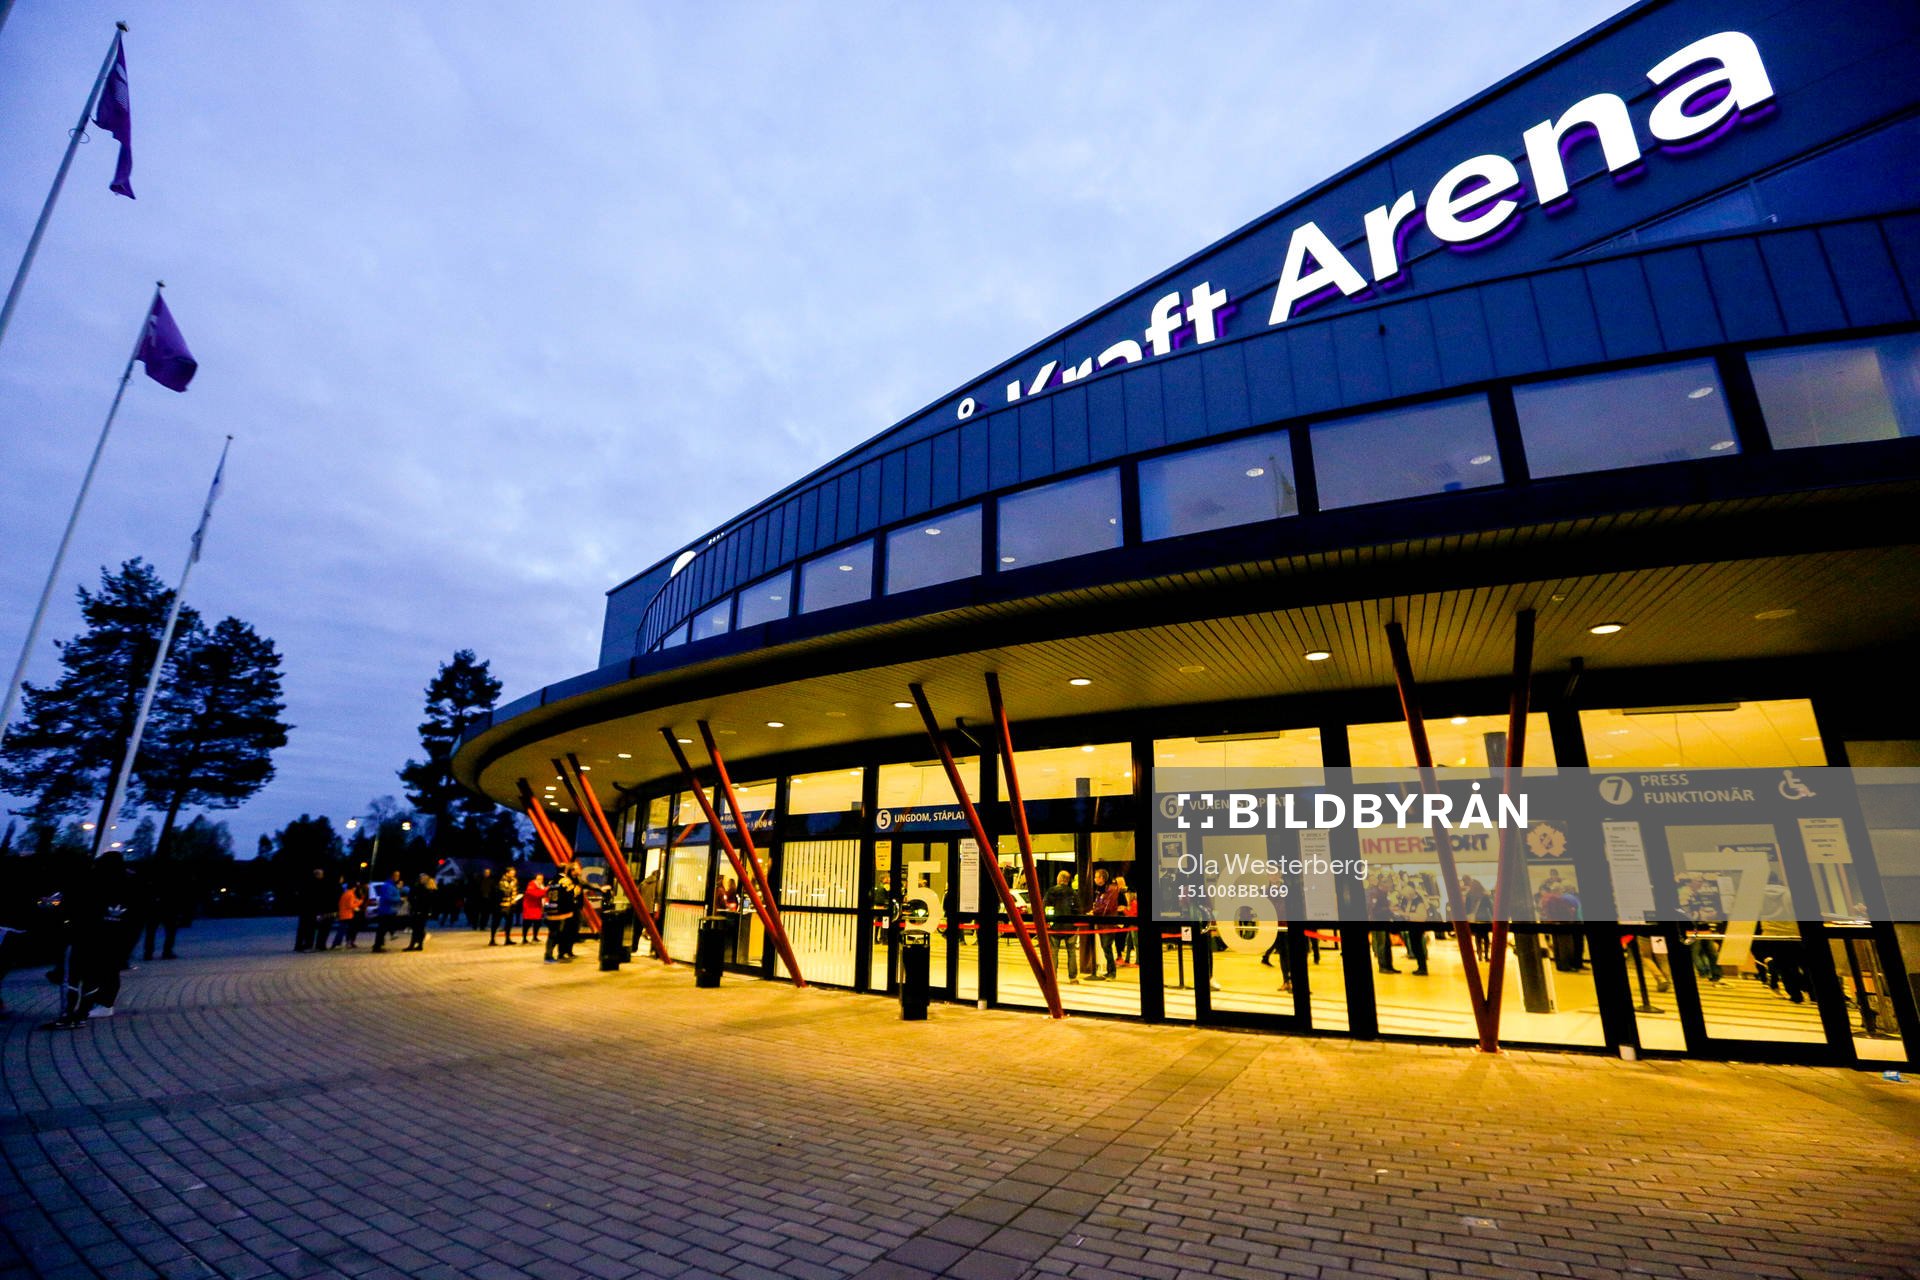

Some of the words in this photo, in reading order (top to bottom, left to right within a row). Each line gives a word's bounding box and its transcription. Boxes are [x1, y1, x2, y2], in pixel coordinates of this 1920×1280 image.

[1268, 31, 1774, 326] Arena
[1640, 774, 1689, 787] PRESS
[1644, 787, 1754, 804] FUNKTIONÄR
[894, 813, 932, 823] UNGDOM,
[933, 810, 965, 821] STÅPLAT
[1362, 833, 1489, 853] INTERSORT
[905, 861, 941, 933] 5
[1682, 851, 1771, 966] 7
